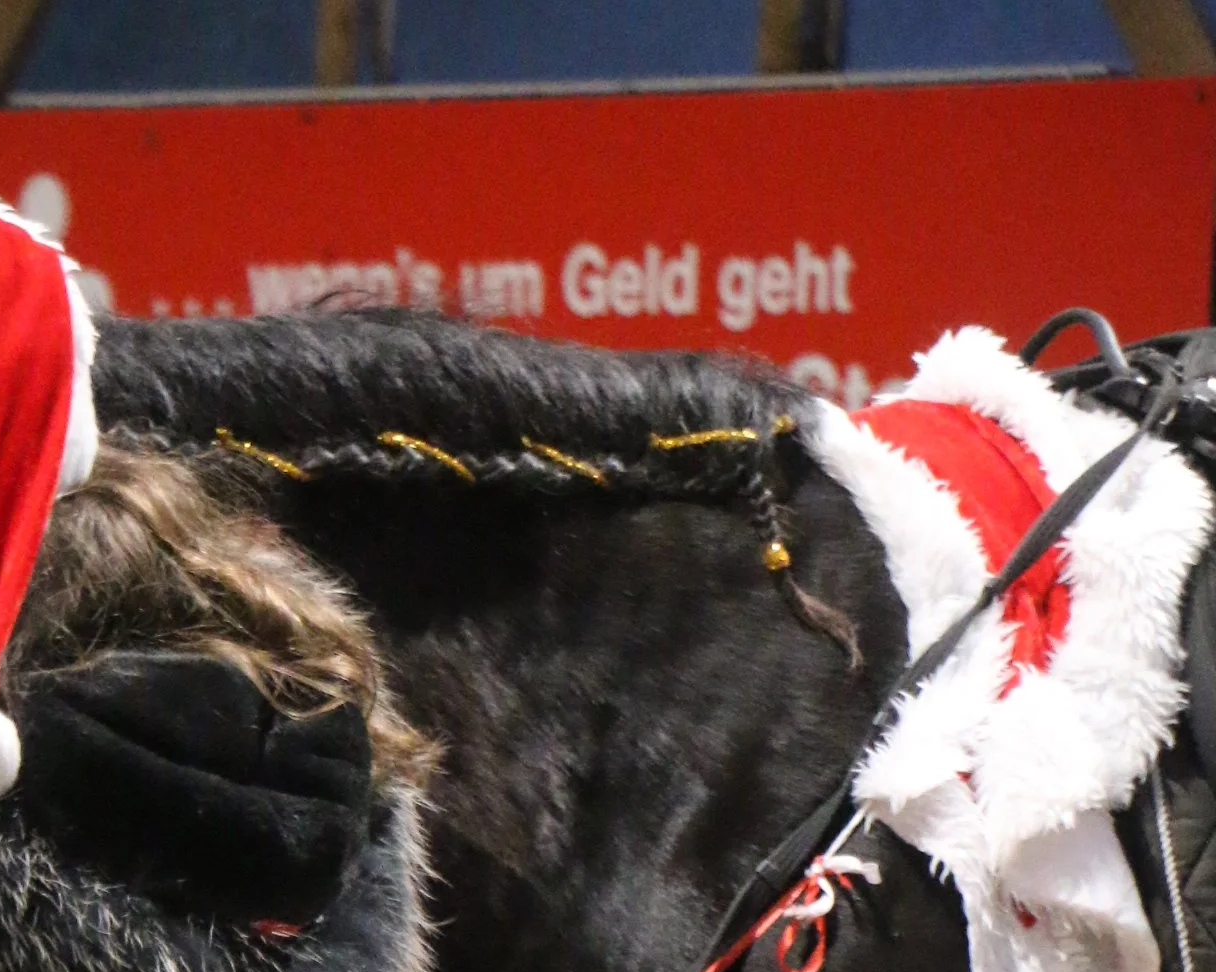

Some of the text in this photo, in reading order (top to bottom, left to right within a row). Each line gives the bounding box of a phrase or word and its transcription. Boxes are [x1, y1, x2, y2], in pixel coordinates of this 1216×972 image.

[459, 261, 543, 317] um
[561, 241, 700, 318] Geld
[716, 240, 855, 332] geht
